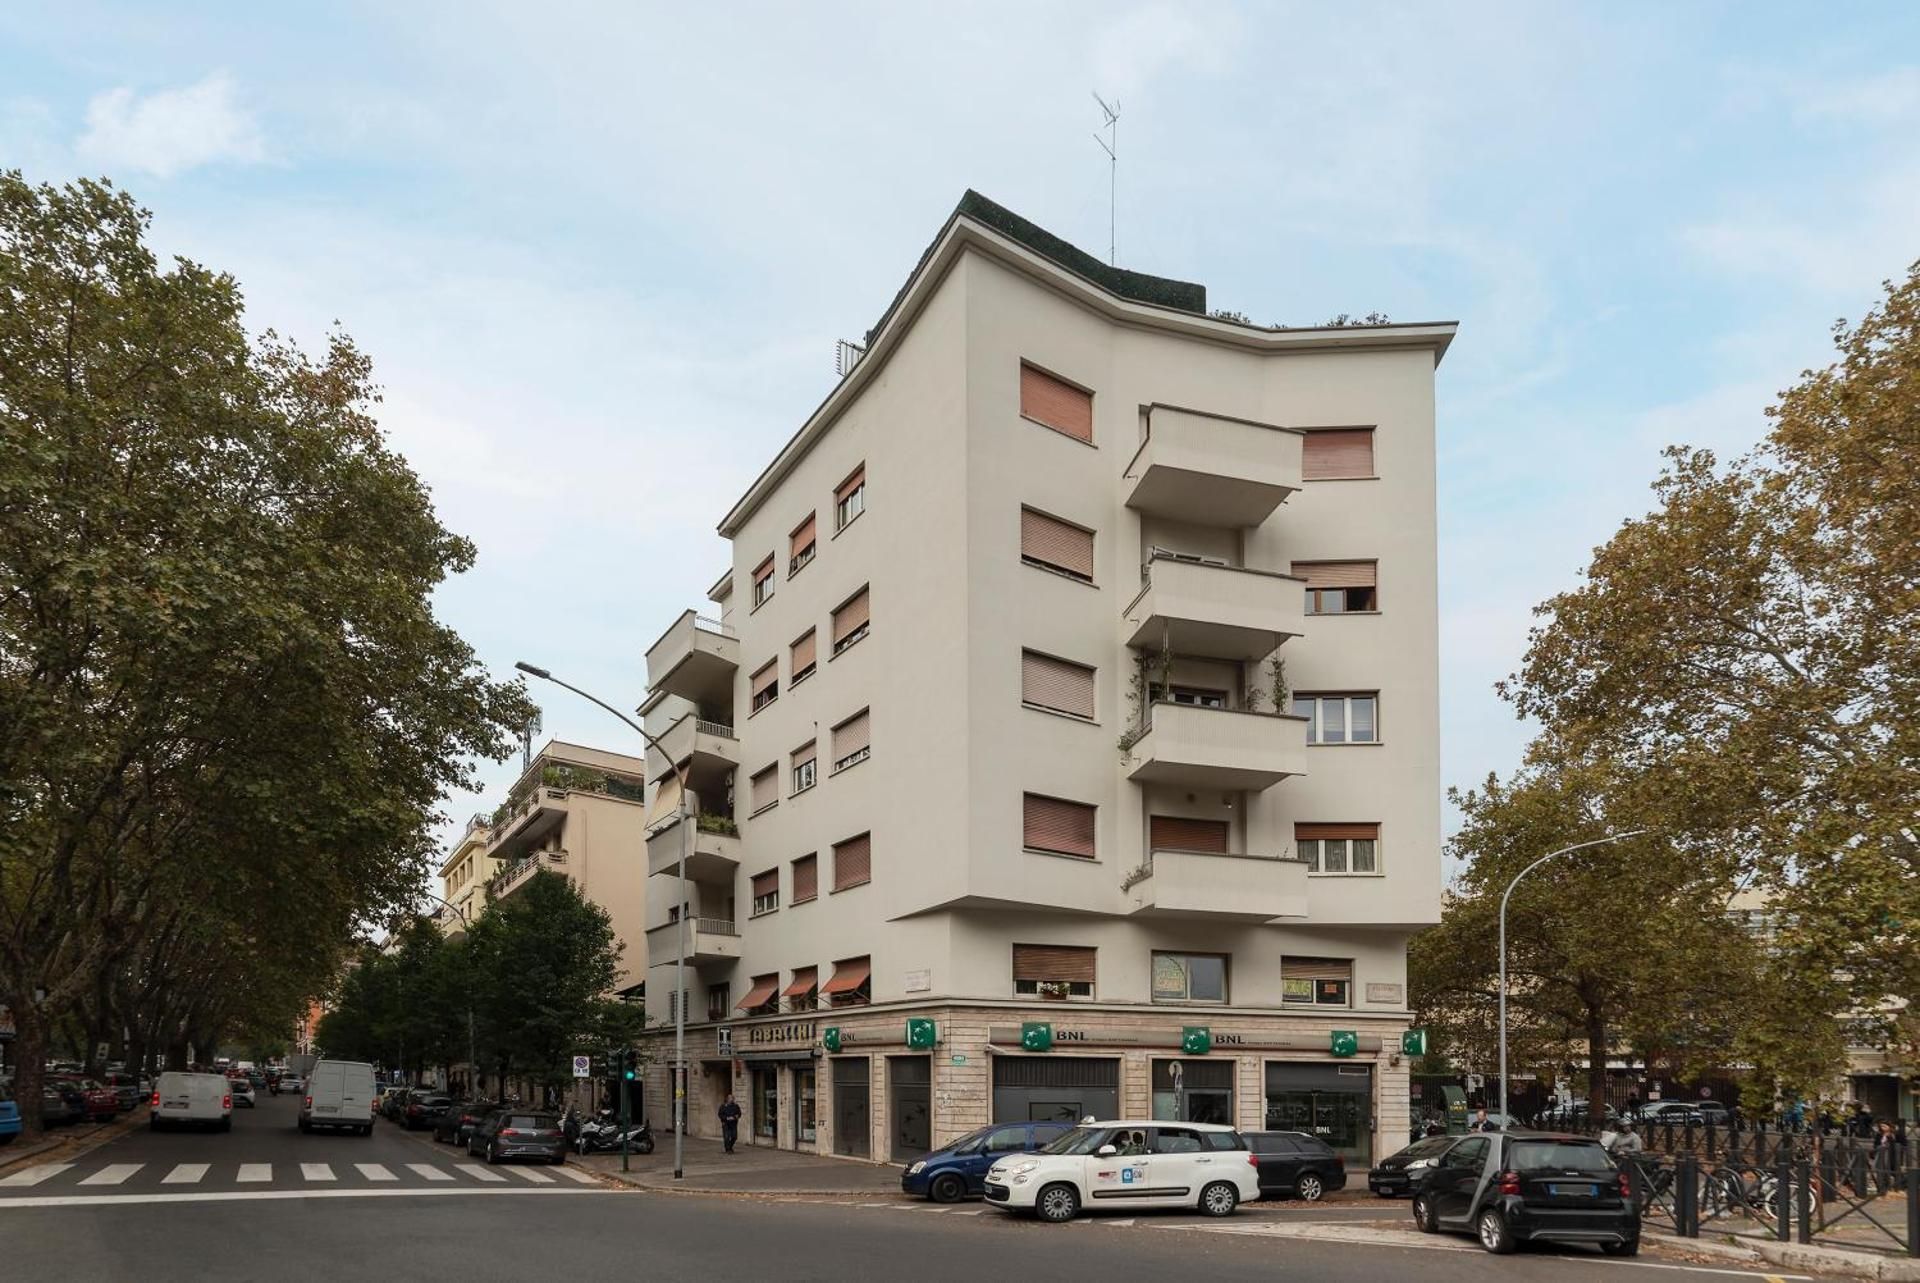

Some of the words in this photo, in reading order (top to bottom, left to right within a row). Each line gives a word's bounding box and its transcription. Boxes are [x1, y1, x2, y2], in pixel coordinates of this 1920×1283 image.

[840, 1032, 857, 1042] BNL
[1056, 1031, 1087, 1041] BNL
[1215, 1035, 1246, 1045] BNL
